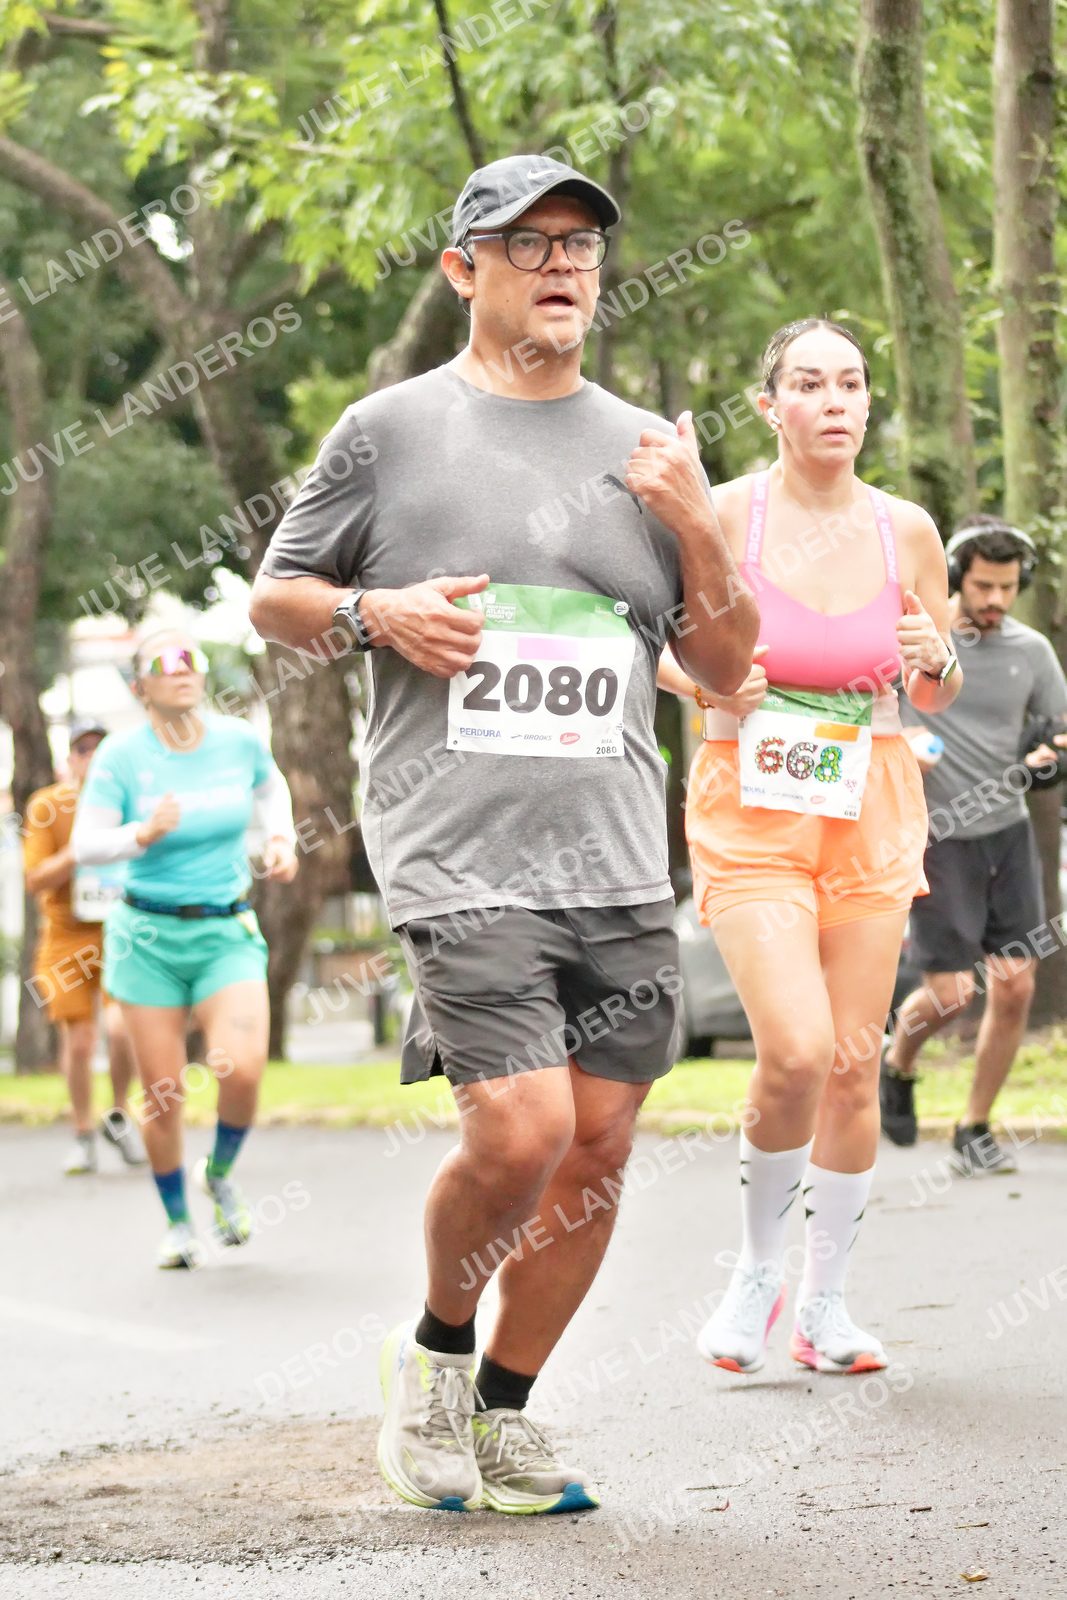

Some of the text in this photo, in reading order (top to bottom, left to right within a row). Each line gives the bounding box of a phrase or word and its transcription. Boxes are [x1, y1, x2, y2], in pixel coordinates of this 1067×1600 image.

[463, 661, 618, 717] 2080
[459, 727, 502, 738] PERDURA
[596, 746, 617, 755] 2080
[754, 736, 843, 785] 668
